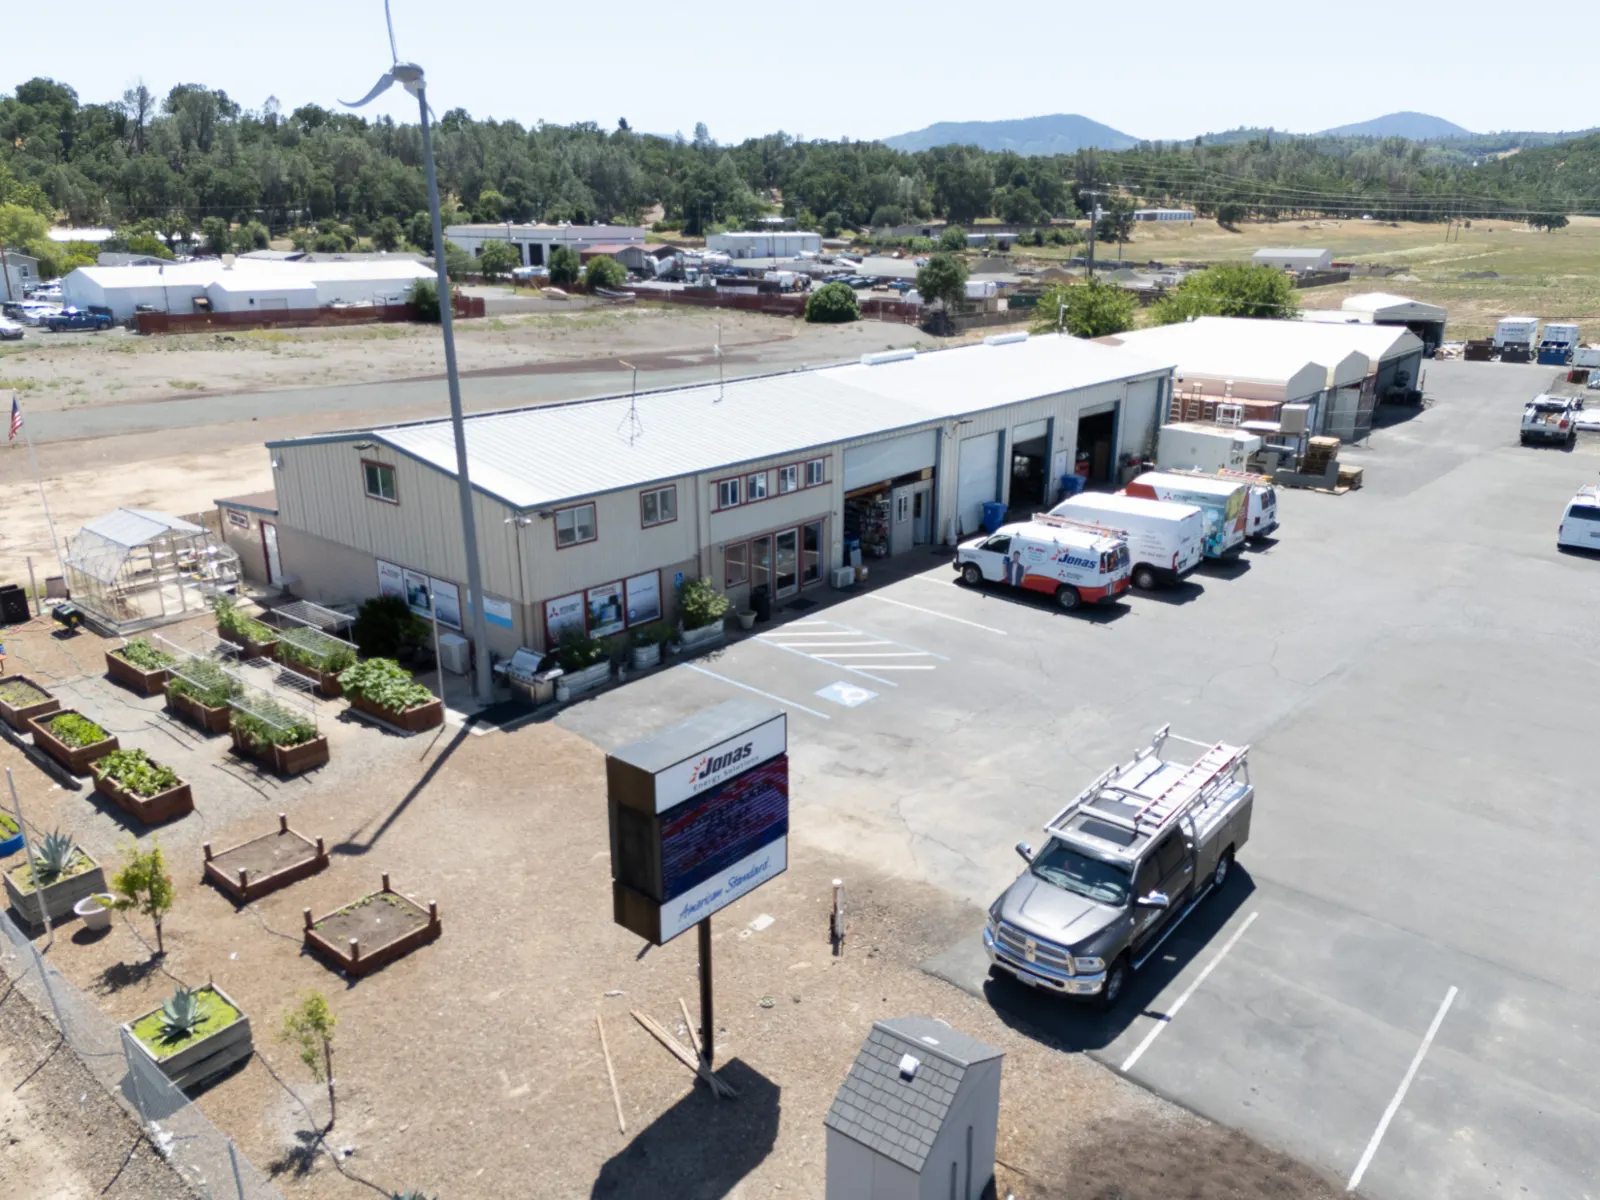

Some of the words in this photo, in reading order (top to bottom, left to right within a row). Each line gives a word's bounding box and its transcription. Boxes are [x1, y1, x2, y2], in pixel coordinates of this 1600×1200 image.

[1058, 554, 1097, 569] Jonas
[699, 742, 753, 780] Jonas
[679, 888, 723, 919] American
[725, 855, 770, 893] Standard
